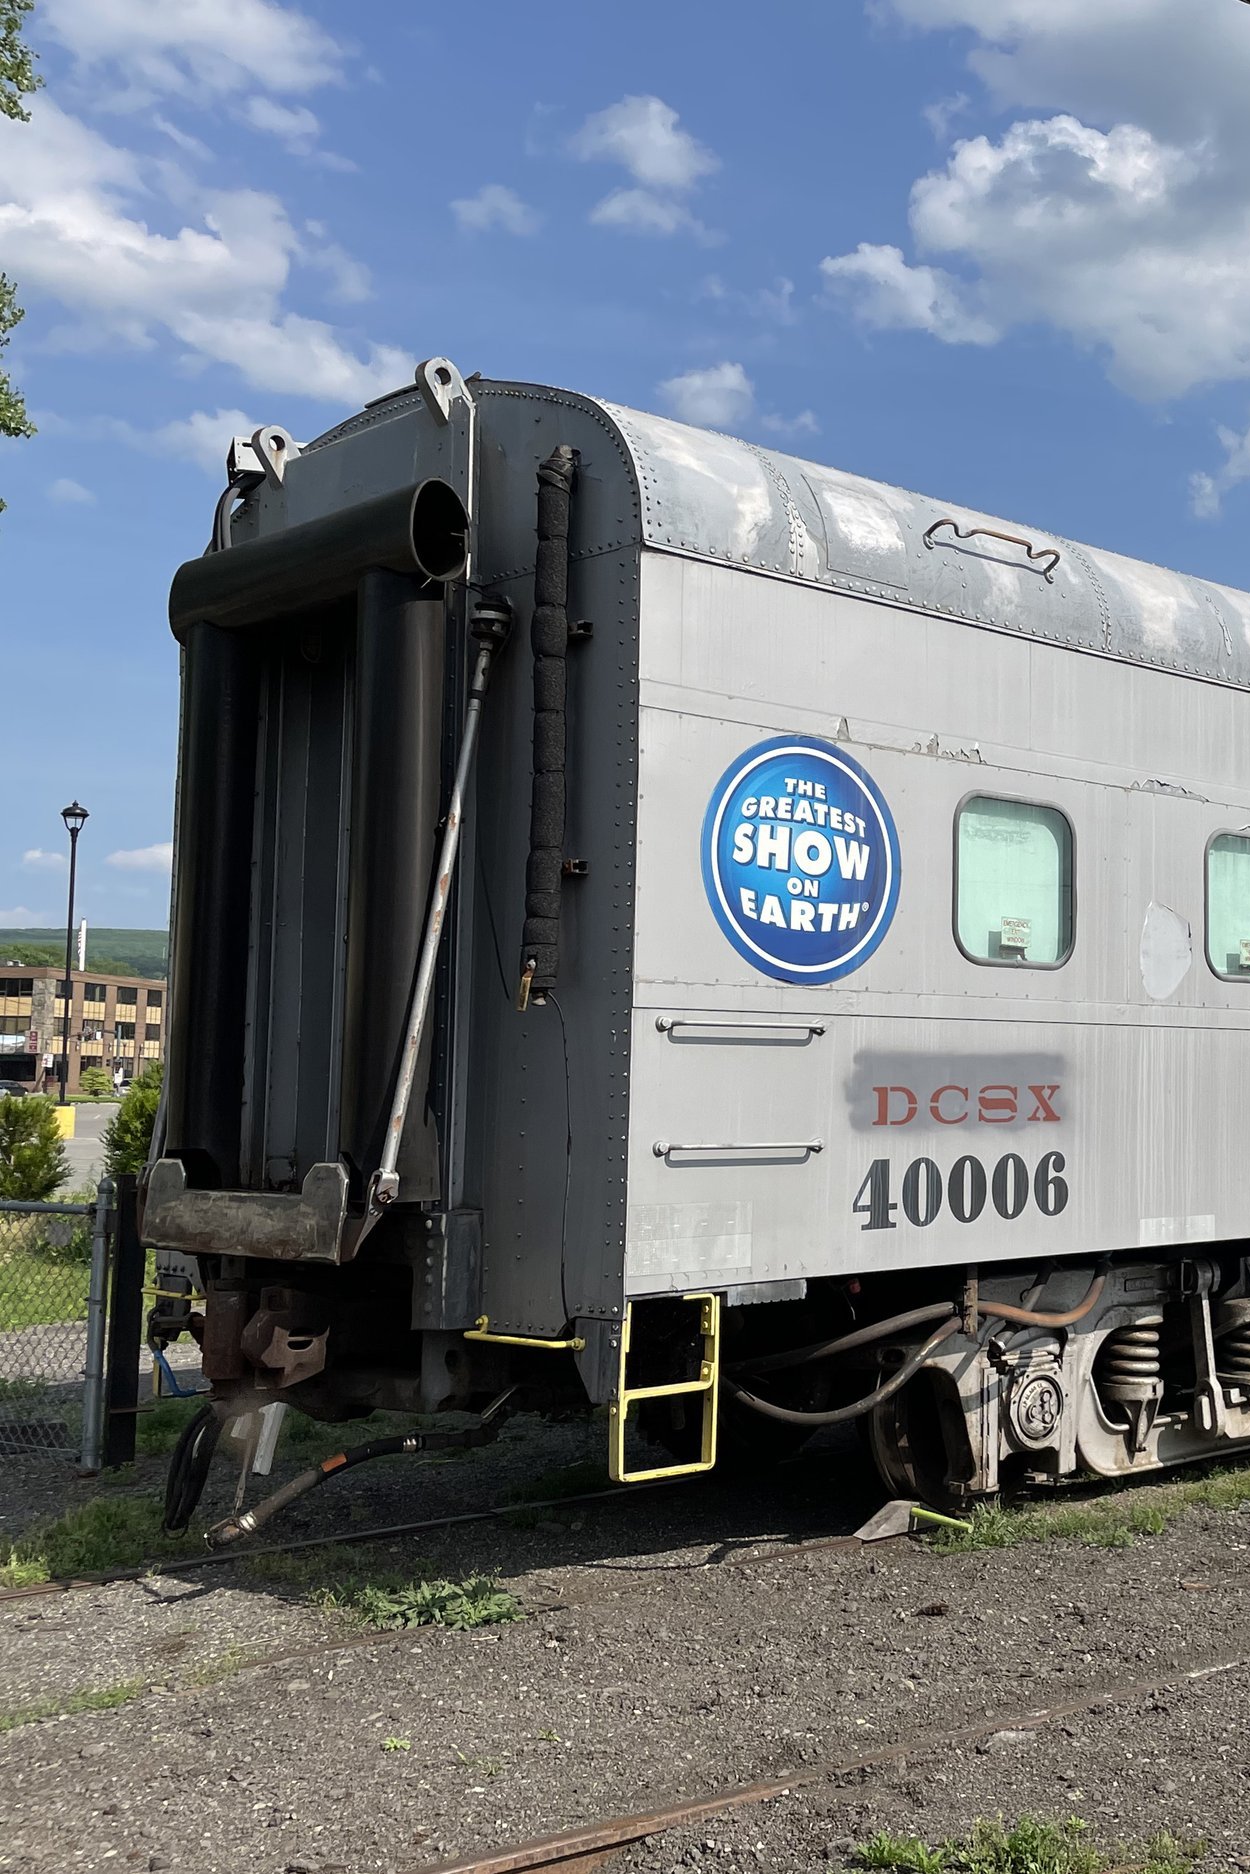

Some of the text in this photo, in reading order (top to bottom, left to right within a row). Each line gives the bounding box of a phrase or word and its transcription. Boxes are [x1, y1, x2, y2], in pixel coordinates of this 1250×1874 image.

[784, 777, 826, 800] THE
[741, 796, 866, 838] GREATEST
[732, 823, 870, 881] SHOW
[786, 877, 819, 898] ON
[871, 1084, 1061, 1126] DCSX
[852, 1150, 1069, 1231] 40006
